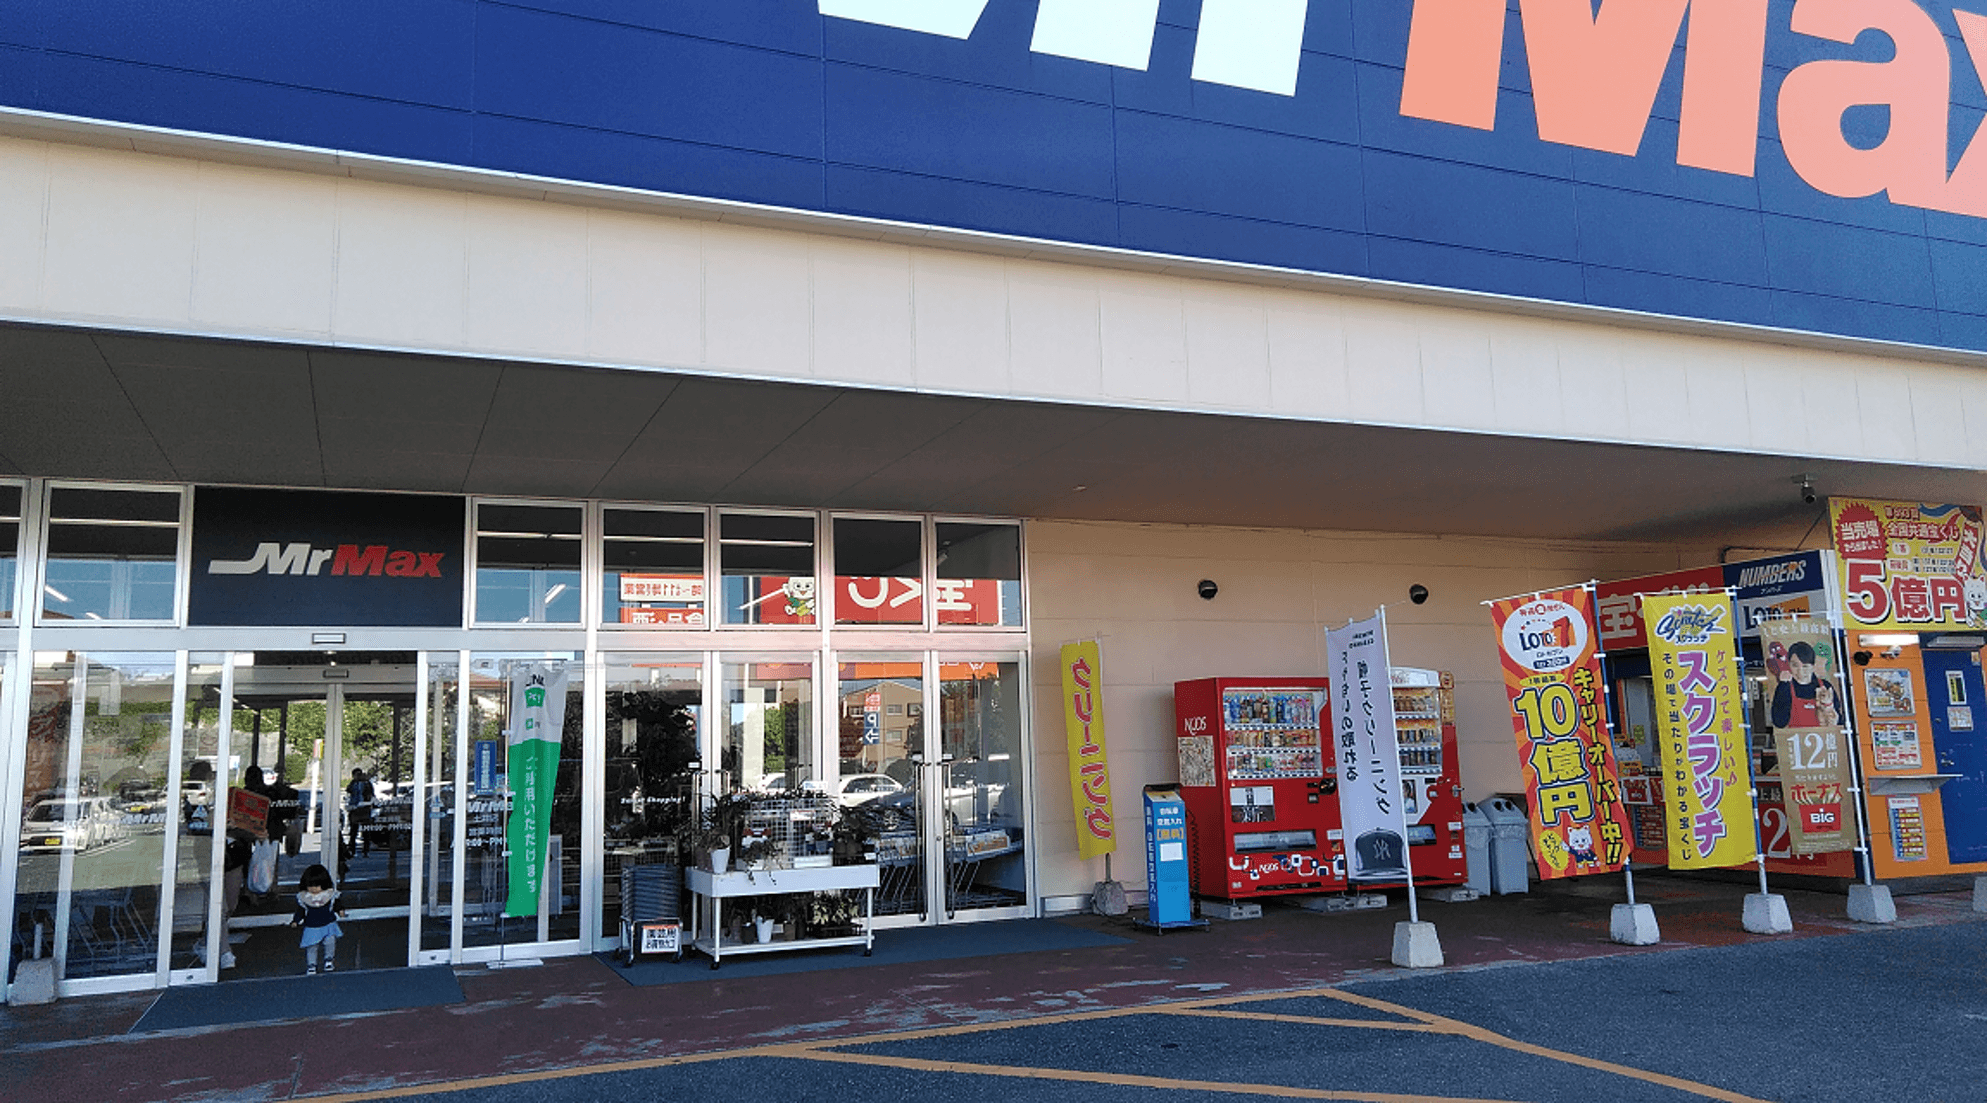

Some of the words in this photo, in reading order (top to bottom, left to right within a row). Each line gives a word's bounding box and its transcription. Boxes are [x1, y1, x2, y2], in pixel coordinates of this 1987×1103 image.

[1840, 520, 1879, 541] 当売場
[1888, 522, 1960, 541] 全国共通宝くじ
[1739, 560, 1807, 588] NUMBERS
[1846, 559, 1966, 624] 5億円
[1677, 651, 1726, 858] スクラッチ
